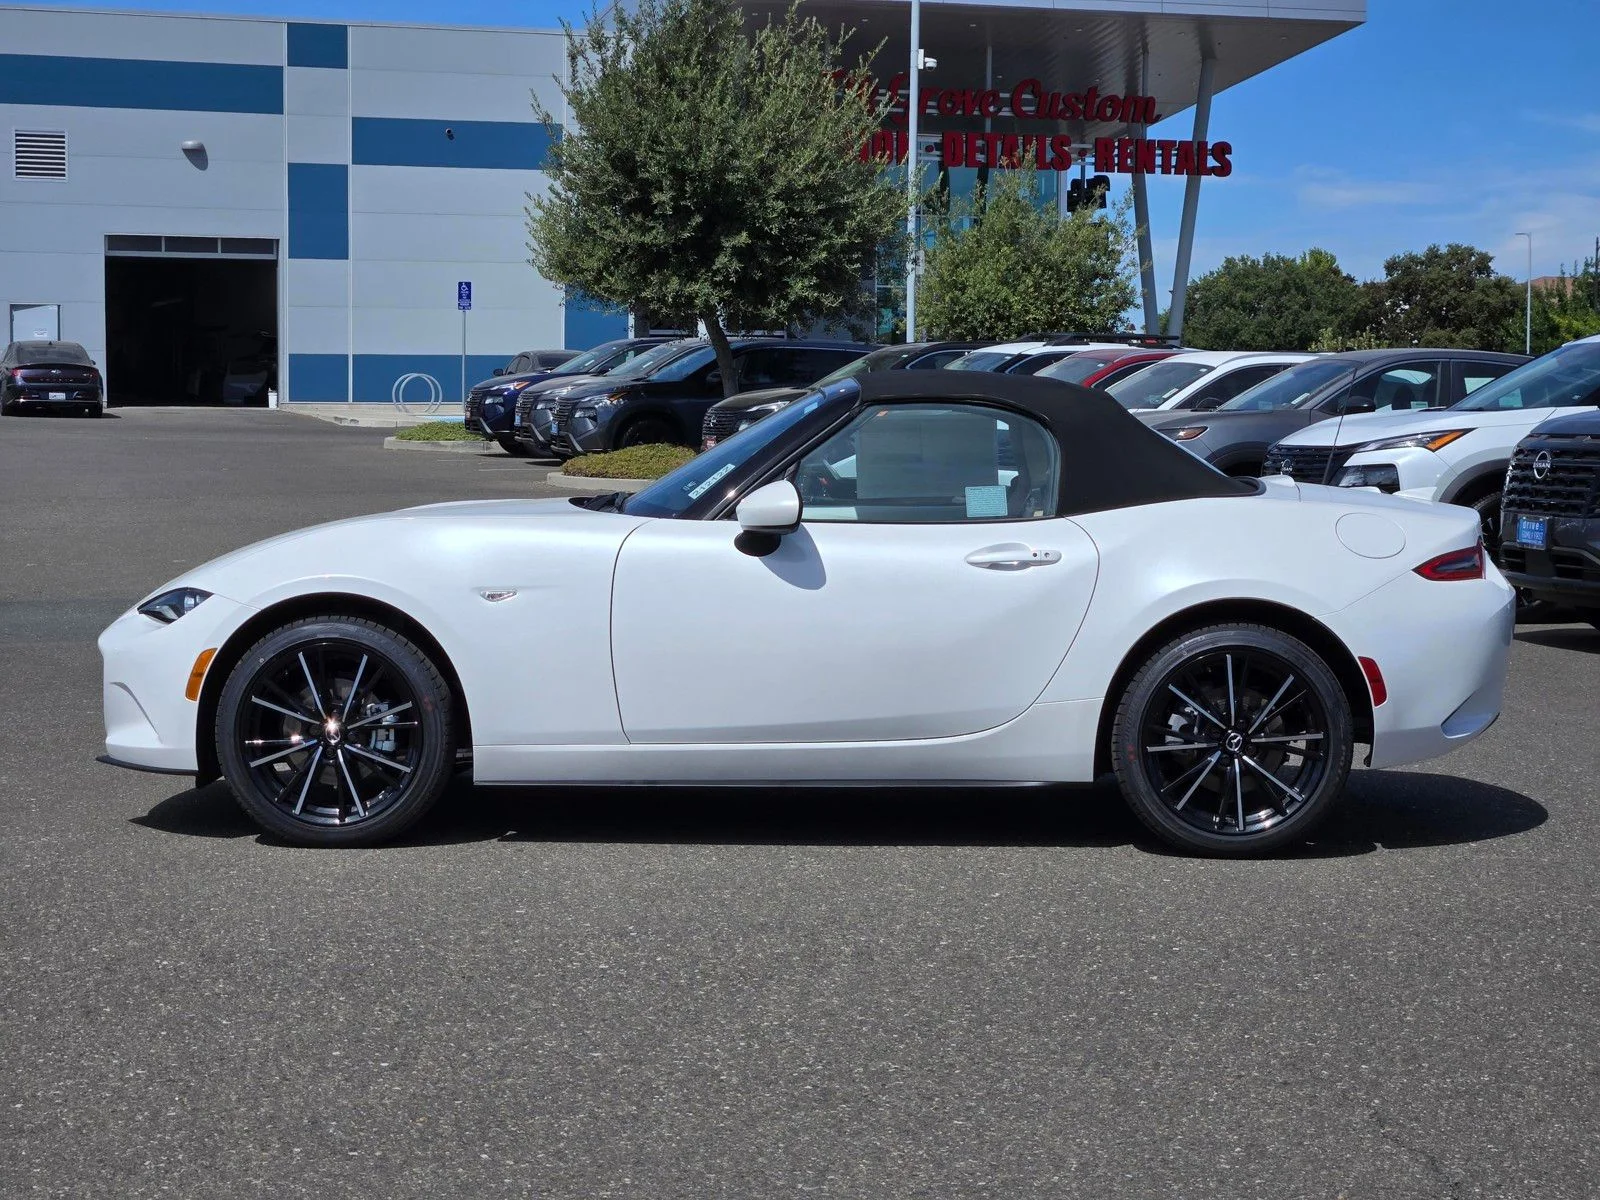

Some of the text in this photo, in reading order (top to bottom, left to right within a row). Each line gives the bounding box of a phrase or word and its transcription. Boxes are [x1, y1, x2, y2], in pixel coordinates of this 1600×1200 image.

[1011, 78, 1162, 124] Custom
[942, 131, 1072, 171] DETAILS
[1094, 137, 1232, 177] RENTALS
